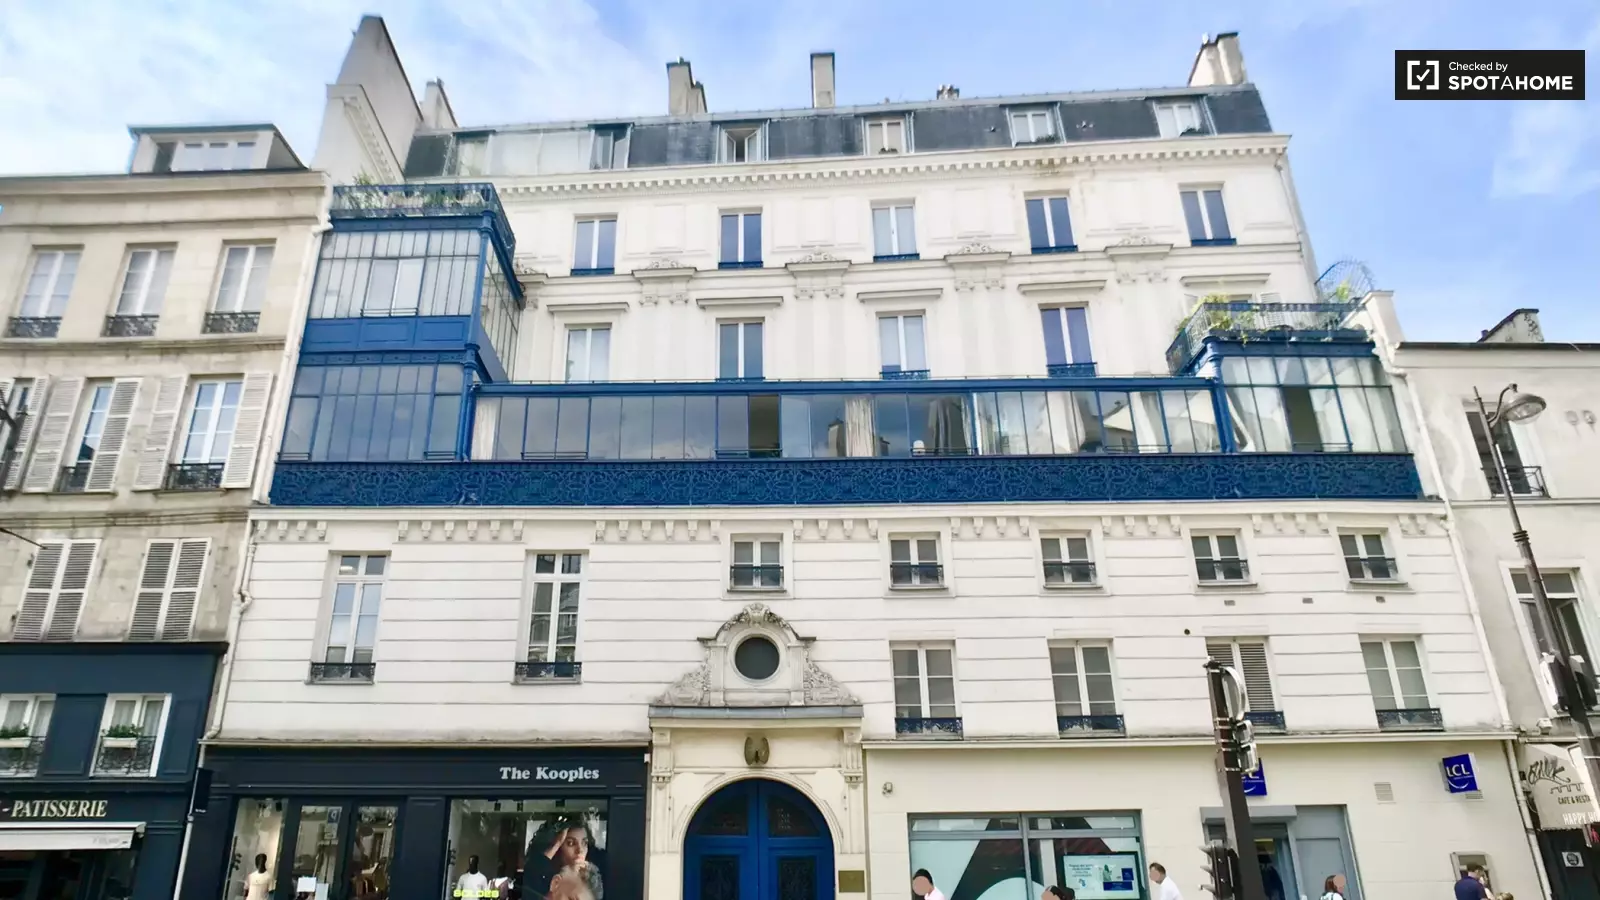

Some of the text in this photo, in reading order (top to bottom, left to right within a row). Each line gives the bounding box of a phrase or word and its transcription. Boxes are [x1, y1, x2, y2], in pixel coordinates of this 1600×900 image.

[499, 766, 600, 783] The Kooples
[1446, 763, 1470, 777] LCL
[1562, 812, 1587, 825] HAPPY
